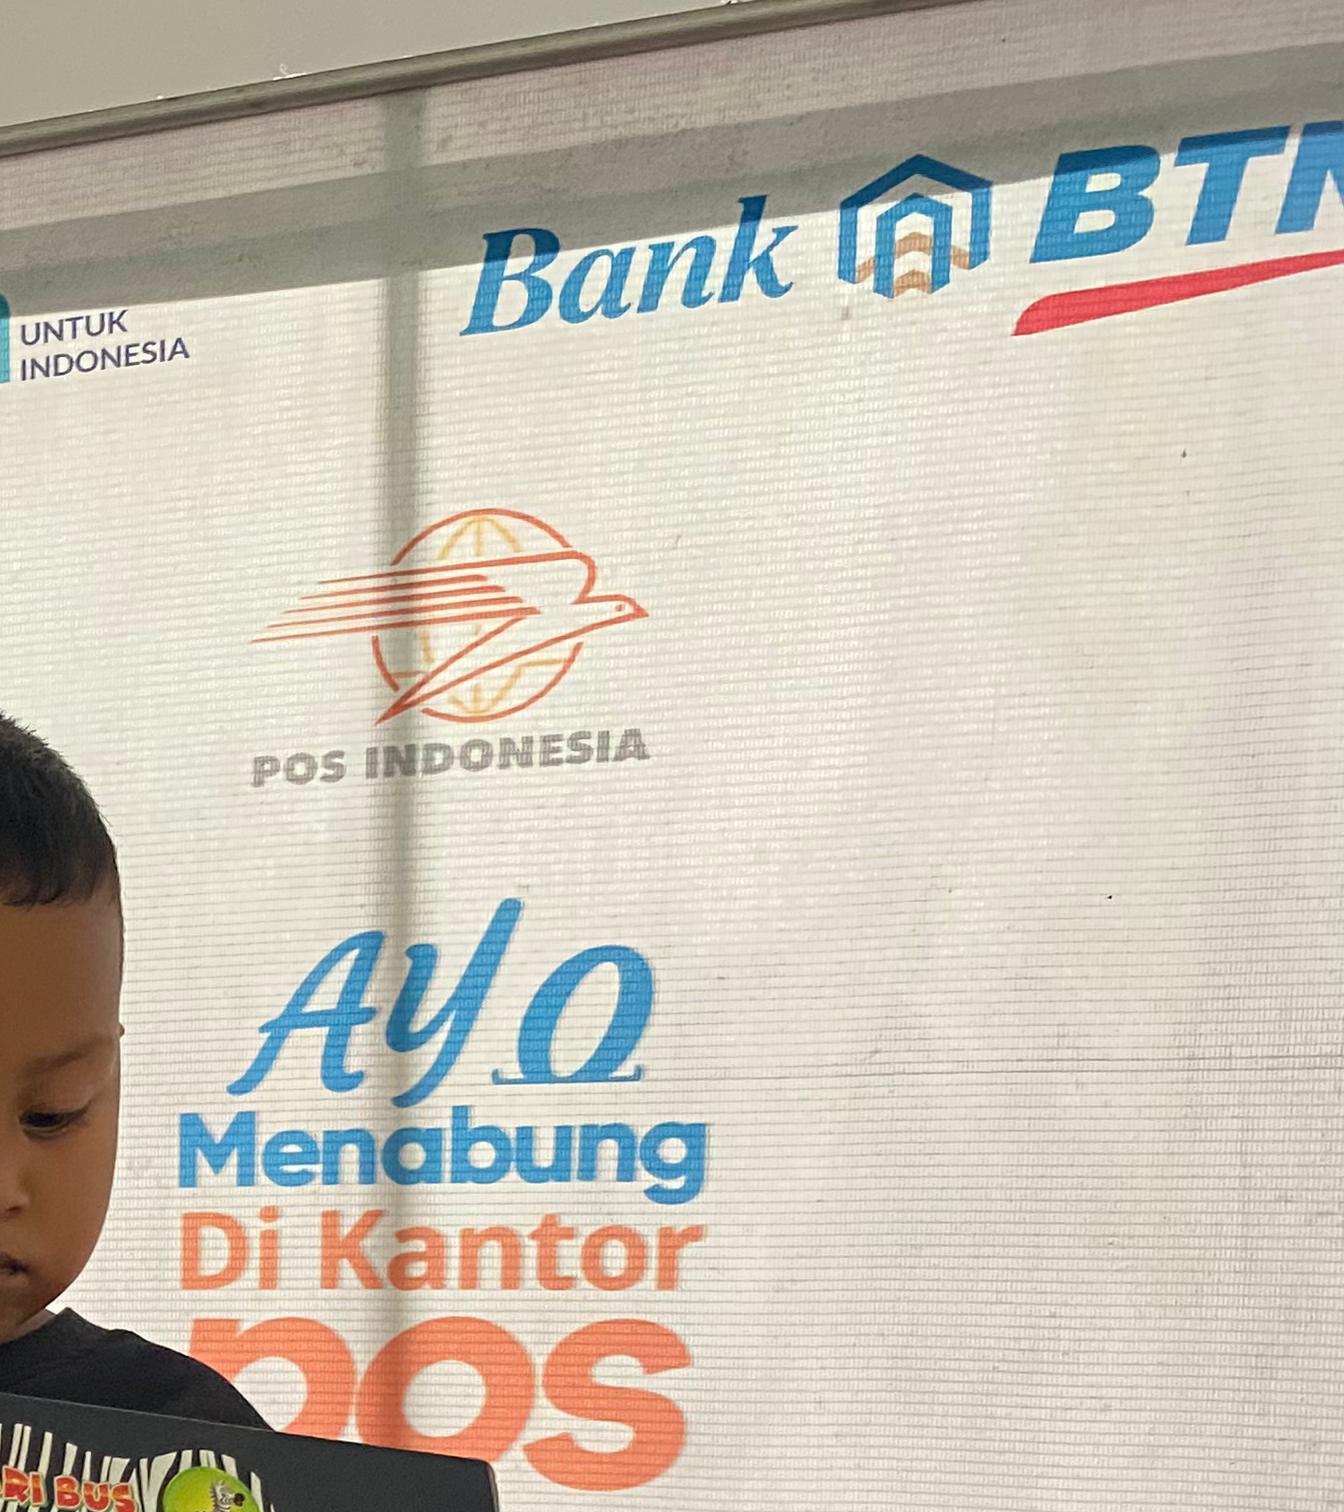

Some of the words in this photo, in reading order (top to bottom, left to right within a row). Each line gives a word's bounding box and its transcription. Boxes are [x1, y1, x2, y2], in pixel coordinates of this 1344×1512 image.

[459, 194, 799, 337] Bank
[20, 309, 128, 346] UNTUK
[20, 336, 190, 382] INDONESIA
[250, 750, 346, 787] POS
[365, 728, 651, 779] INDONESIA
[227, 897, 655, 1107] AYO
[178, 1105, 708, 1205] Menabung
[179, 1205, 281, 1291] Di
[319, 1209, 707, 1292] Kantor
